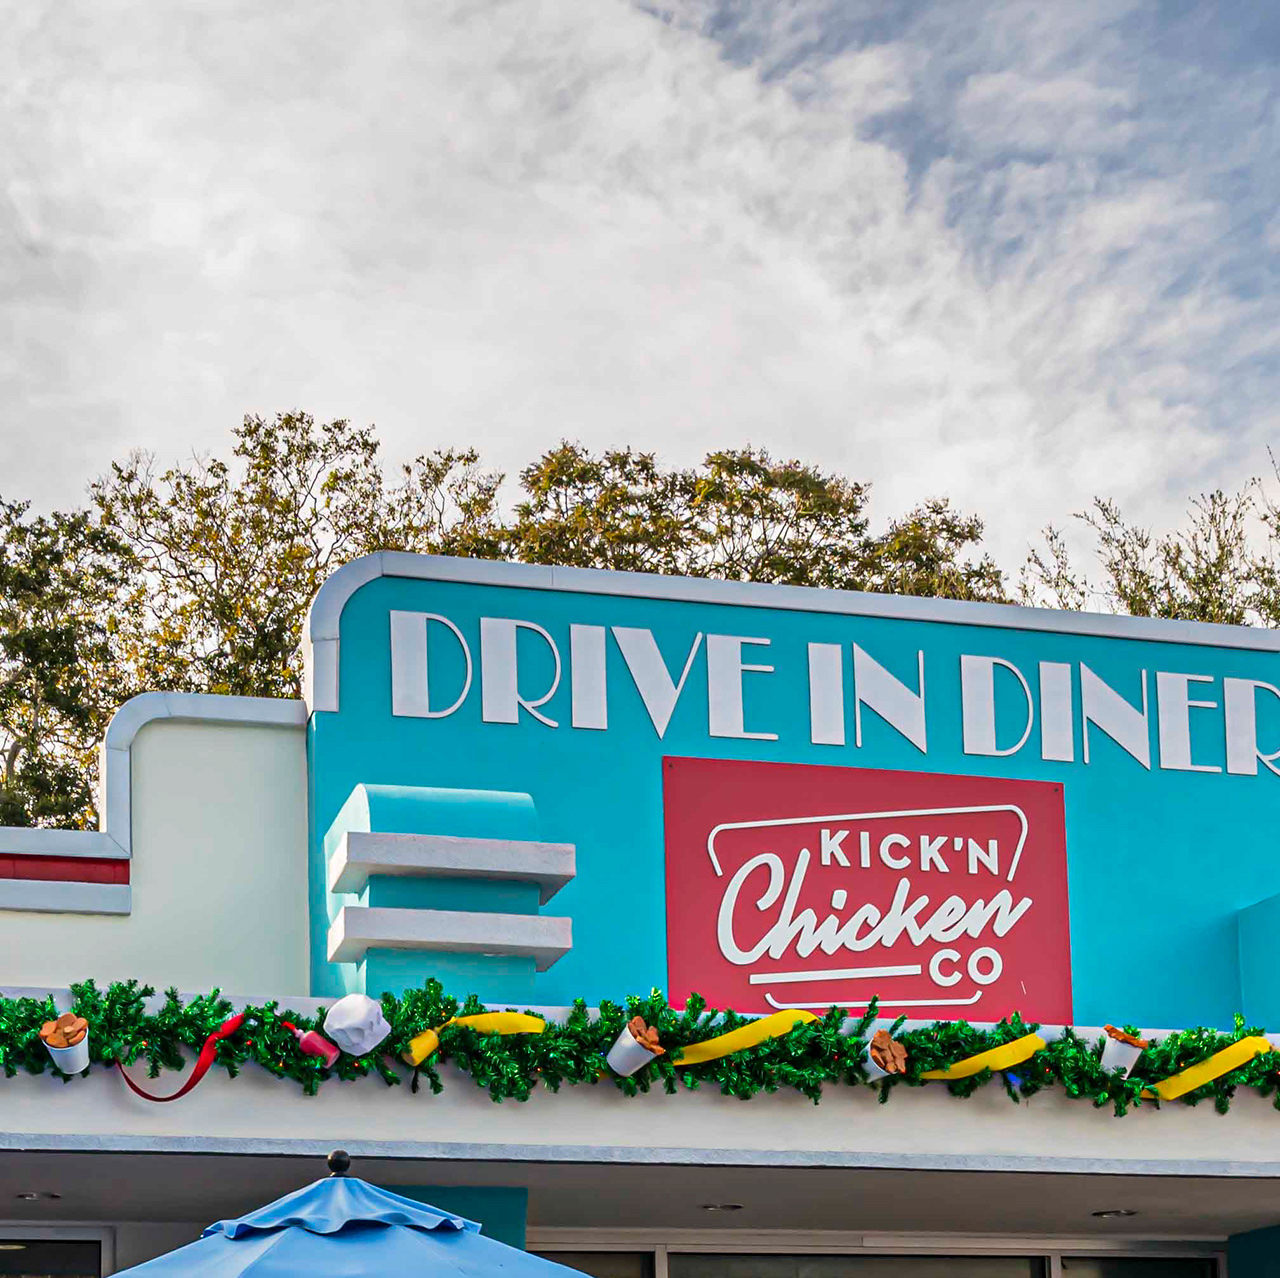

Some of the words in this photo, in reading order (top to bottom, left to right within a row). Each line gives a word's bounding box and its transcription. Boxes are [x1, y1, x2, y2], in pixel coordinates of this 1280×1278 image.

[390, 610, 779, 741] DRIVE
[808, 642, 927, 753] IN
[820, 829, 1000, 876] KICK'N
[717, 847, 1033, 965] Chicken
[931, 947, 1003, 986] CO
